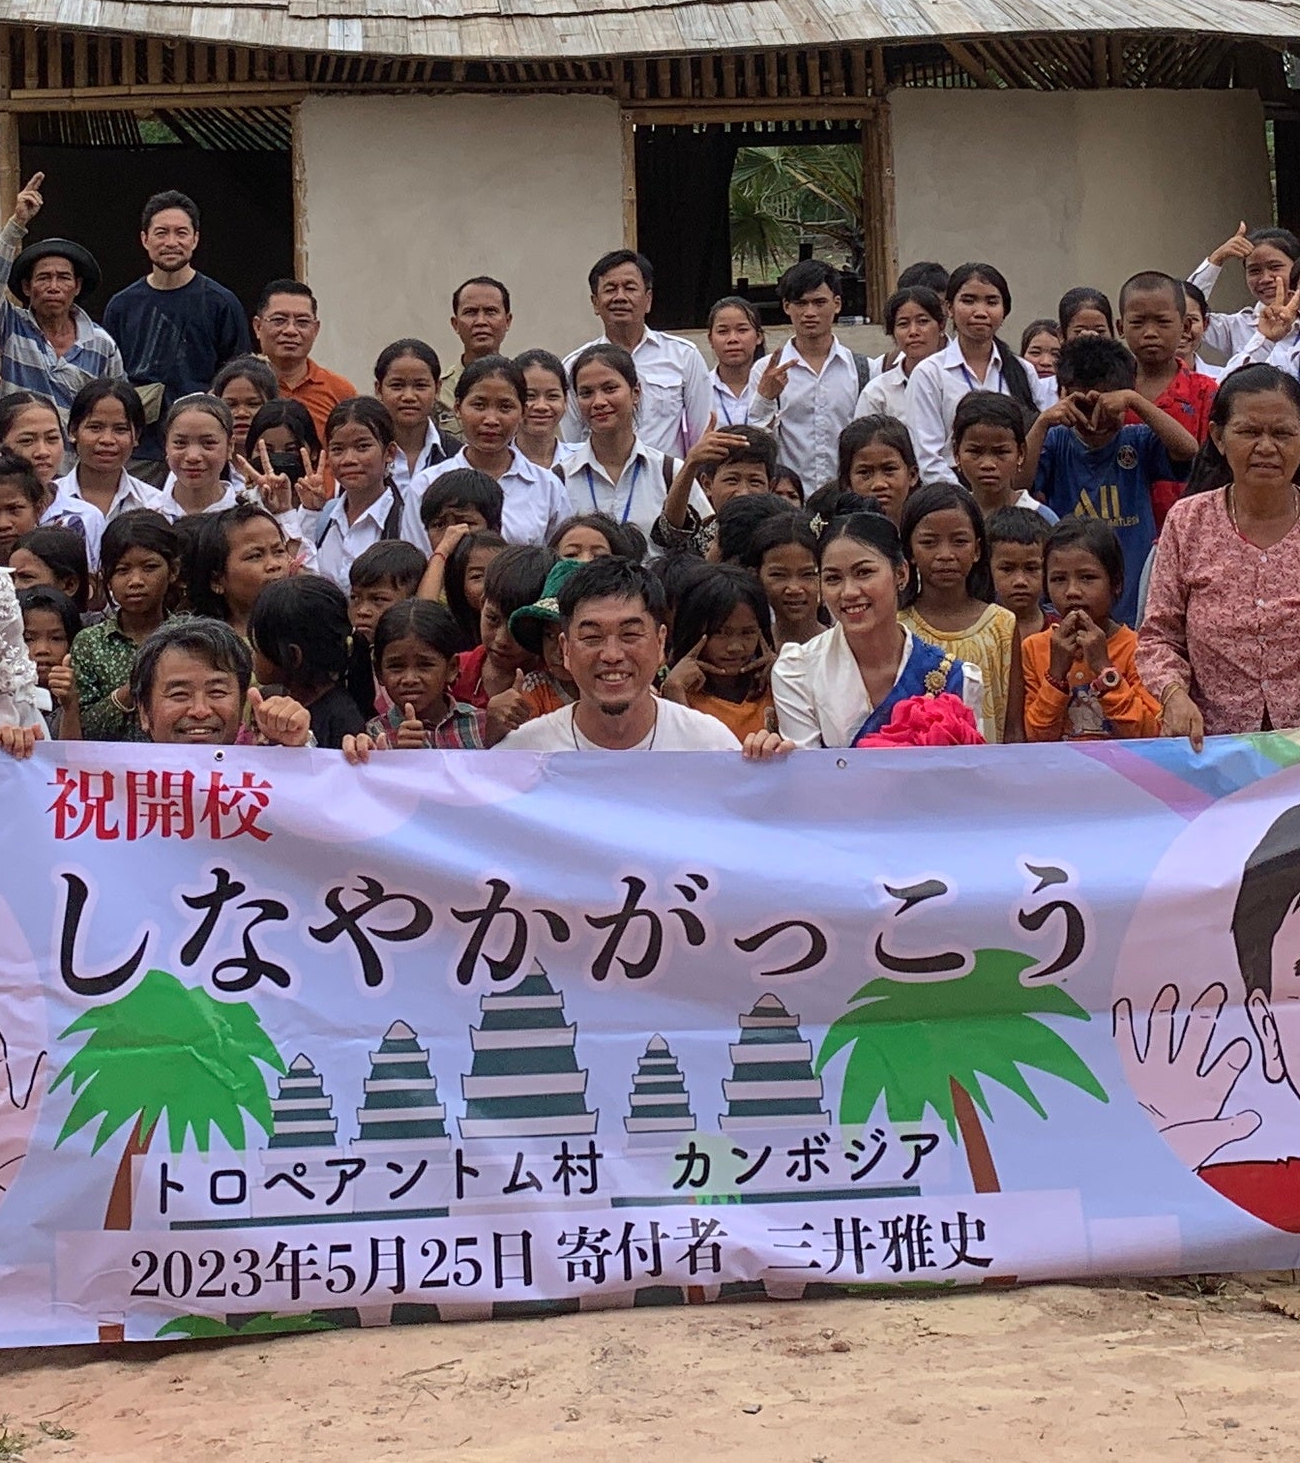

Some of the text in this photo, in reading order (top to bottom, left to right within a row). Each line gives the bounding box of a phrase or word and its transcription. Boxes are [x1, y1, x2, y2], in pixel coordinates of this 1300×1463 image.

[45, 767, 274, 842] 祝開校
[60, 862, 1086, 997] しなやかがっこう
[160, 1128, 941, 1215] トロペアントム村 カンボジア
[129, 1210, 995, 1302] 2023年5月25日 寄付者 三井雅史
